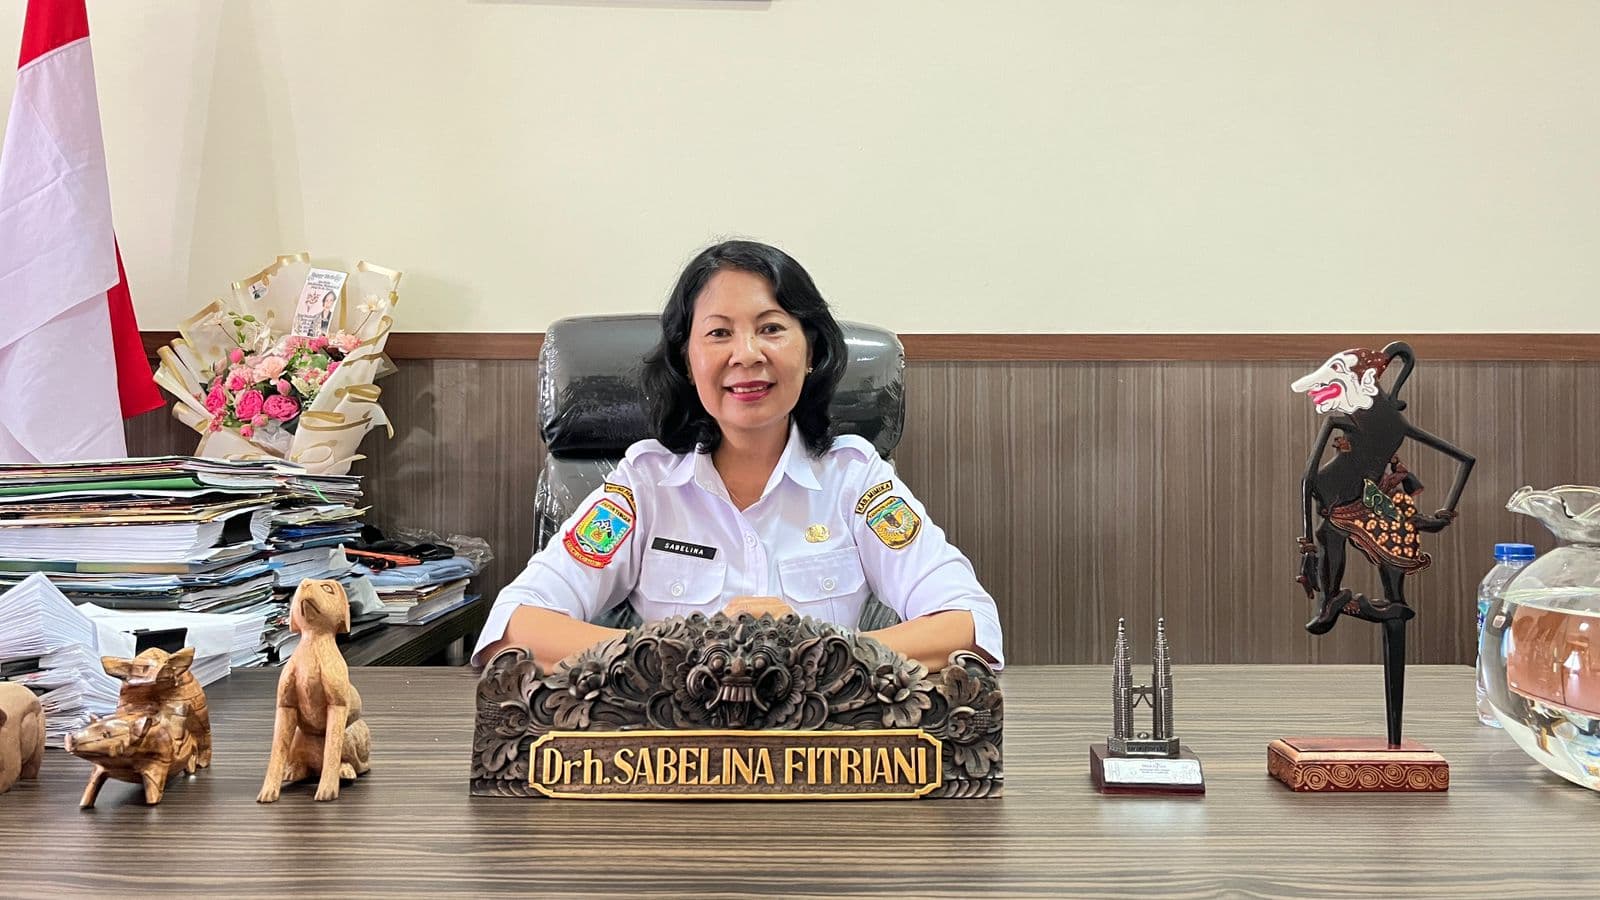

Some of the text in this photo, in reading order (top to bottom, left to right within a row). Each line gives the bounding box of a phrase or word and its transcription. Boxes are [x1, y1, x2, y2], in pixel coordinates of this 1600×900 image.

[868, 483, 890, 498] MIMIKA
[664, 542, 704, 556] SABELINA
[542, 747, 927, 785] Drh. SABELINA FITRIANI
